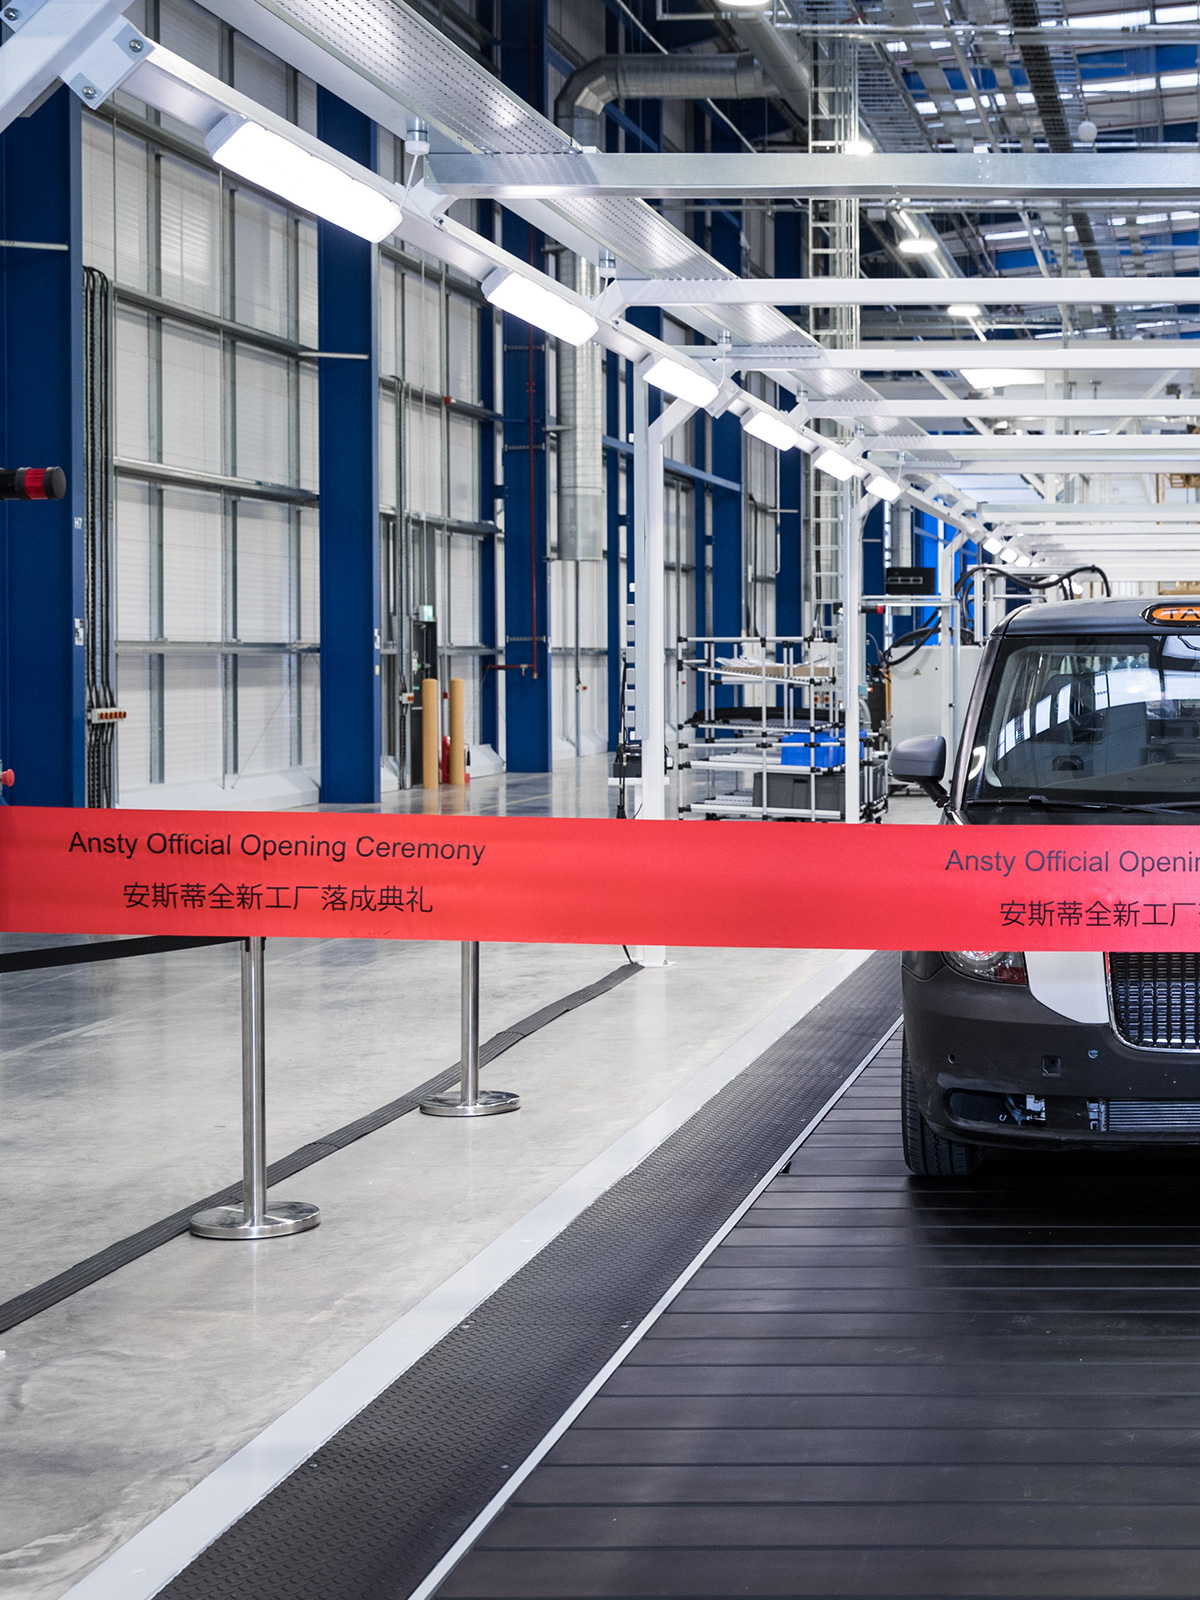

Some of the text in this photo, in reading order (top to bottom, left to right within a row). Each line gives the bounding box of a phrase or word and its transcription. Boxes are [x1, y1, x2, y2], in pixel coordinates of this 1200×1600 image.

[69, 832, 486, 866] Ansty Official Opening Ceremony
[945, 850, 1016, 877] Ansty
[1025, 850, 1108, 872] Official
[123, 882, 433, 912] 安斯蒂全新工厂落成典礼
